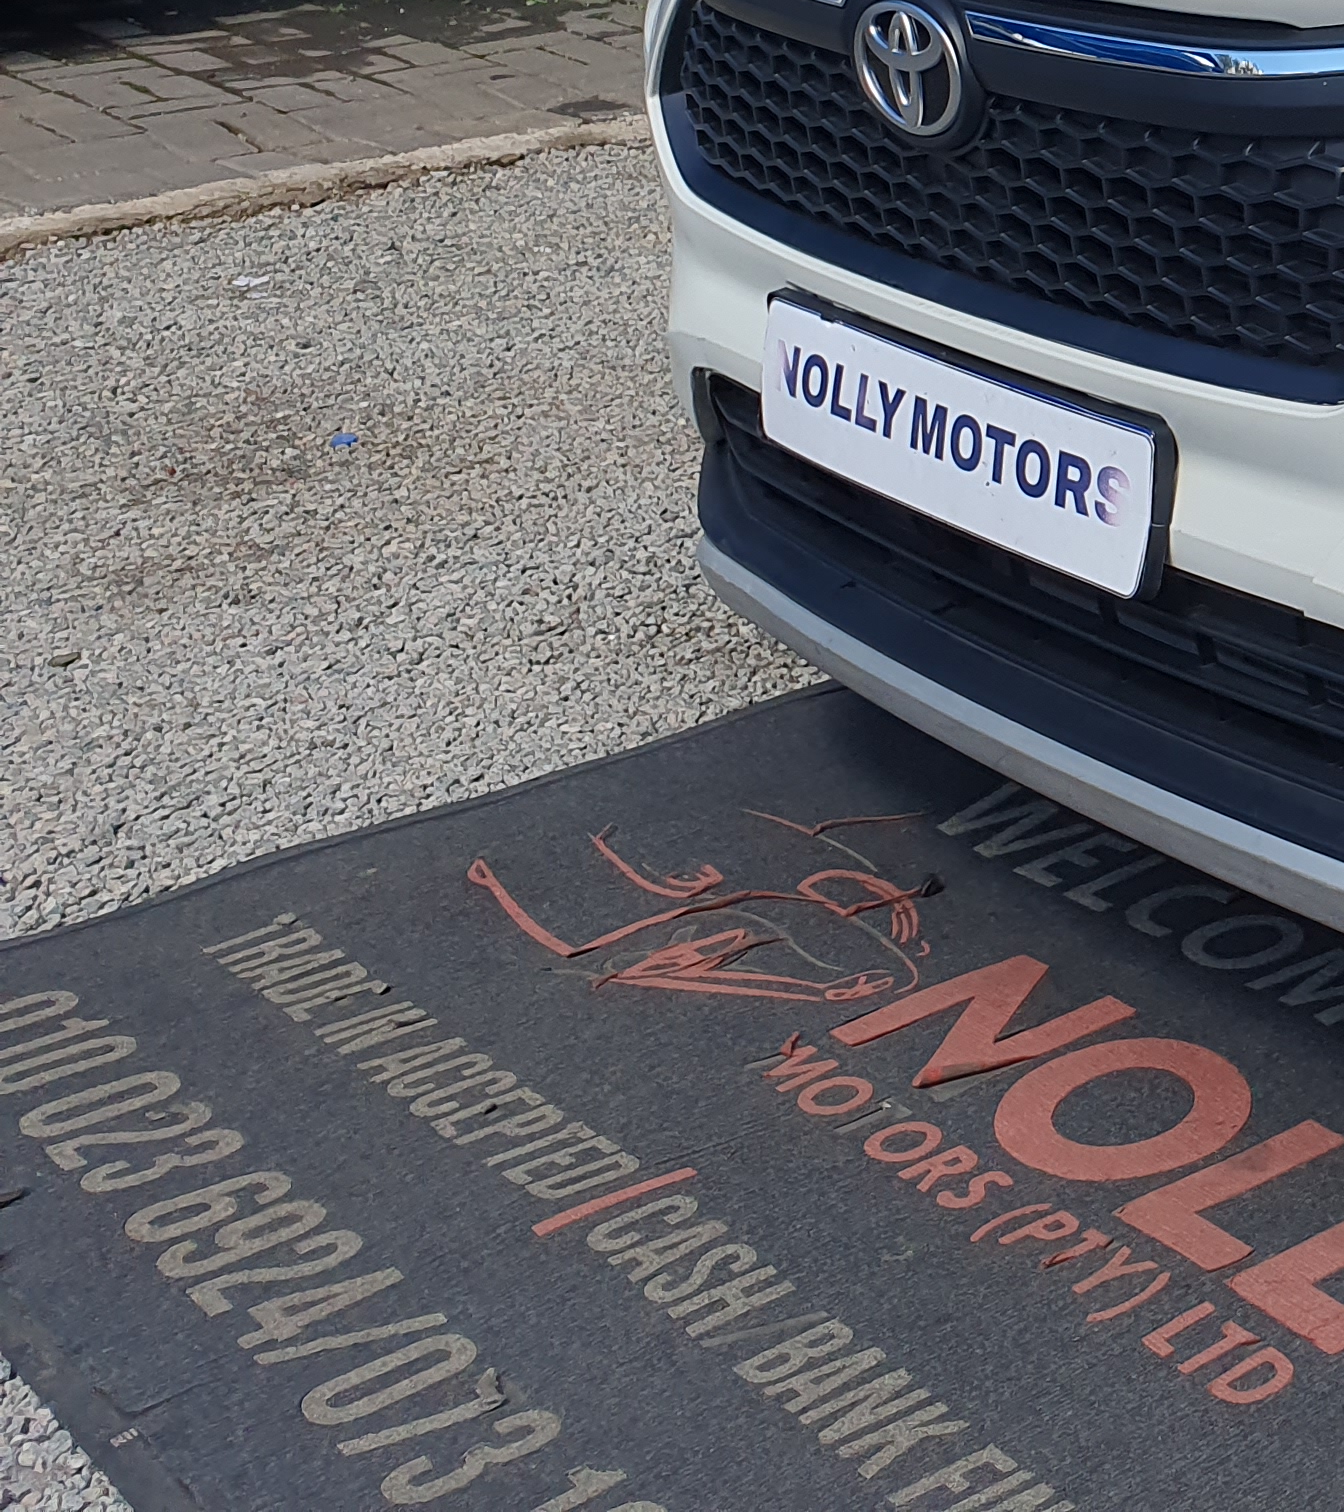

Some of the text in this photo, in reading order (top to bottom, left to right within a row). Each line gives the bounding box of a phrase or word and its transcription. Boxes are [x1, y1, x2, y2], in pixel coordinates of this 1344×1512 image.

[776, 340, 1131, 527] NOLLY MOTORS
[202, 912, 392, 1023] TRADE
[313, 1000, 438, 1055] IN
[18, 1070, 245, 1193] 023
[356, 1036, 641, 1200] ACCEPTED
[969, 1203, 1170, 1324] (PTY)
[1141, 1301, 1295, 1405] LTD
[732, 1318, 971, 1480] BANK
